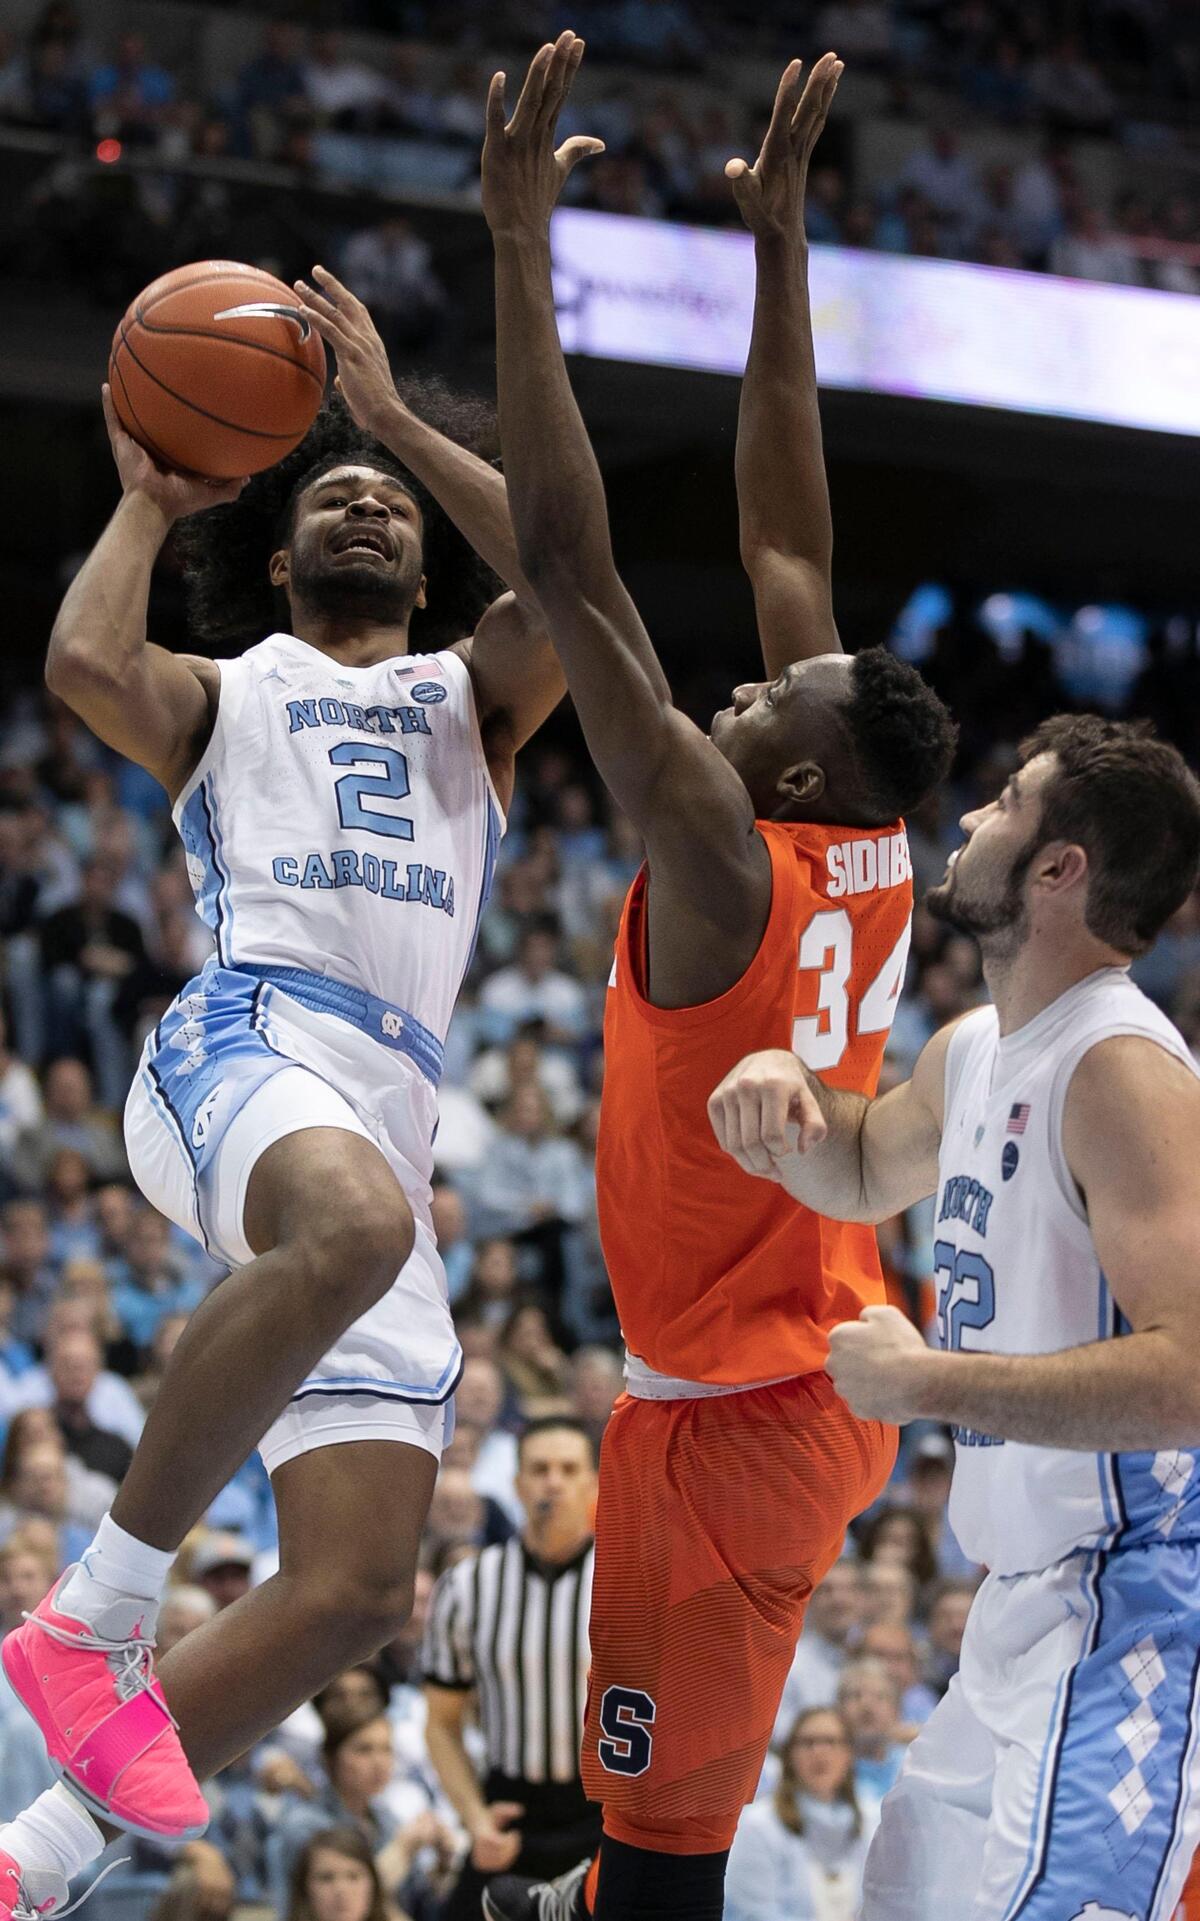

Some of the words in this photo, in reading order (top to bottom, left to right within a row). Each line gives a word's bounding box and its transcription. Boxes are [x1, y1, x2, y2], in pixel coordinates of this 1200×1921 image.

[286, 698, 432, 735] NORTH
[328, 741, 414, 842] 2
[272, 849, 454, 917] CAROLINA
[826, 832, 913, 897] SIDIB
[791, 908, 912, 1072] 34
[938, 1175, 994, 1239] NORTH
[934, 1240, 995, 1351] 32
[599, 1685, 656, 1777] S
